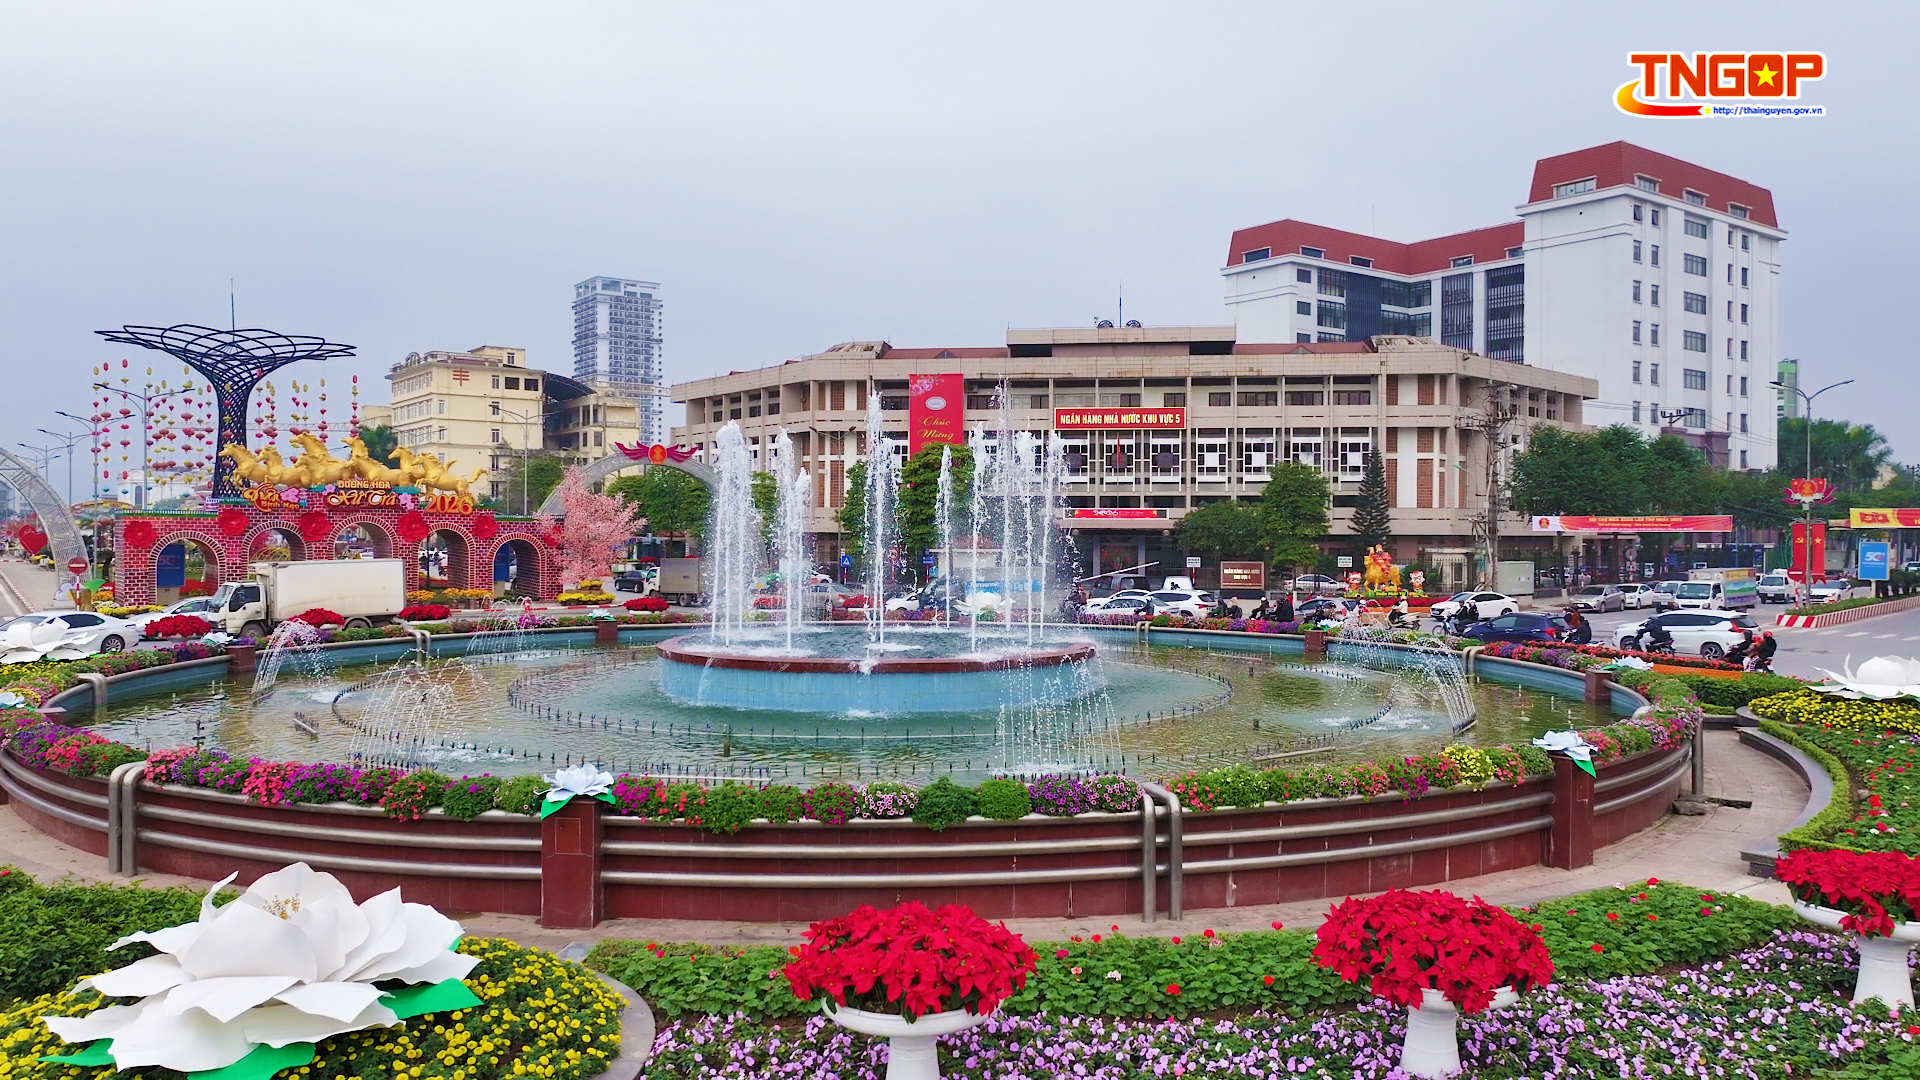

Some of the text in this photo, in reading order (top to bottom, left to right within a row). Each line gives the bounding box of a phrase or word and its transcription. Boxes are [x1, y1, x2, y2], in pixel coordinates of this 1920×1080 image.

[1060, 411, 1180, 425] NGÂN HÀNG NHÀ NƯỚC KHU VỰC 5
[372, 480, 391, 489] HOA
[424, 492, 474, 515] 2026
